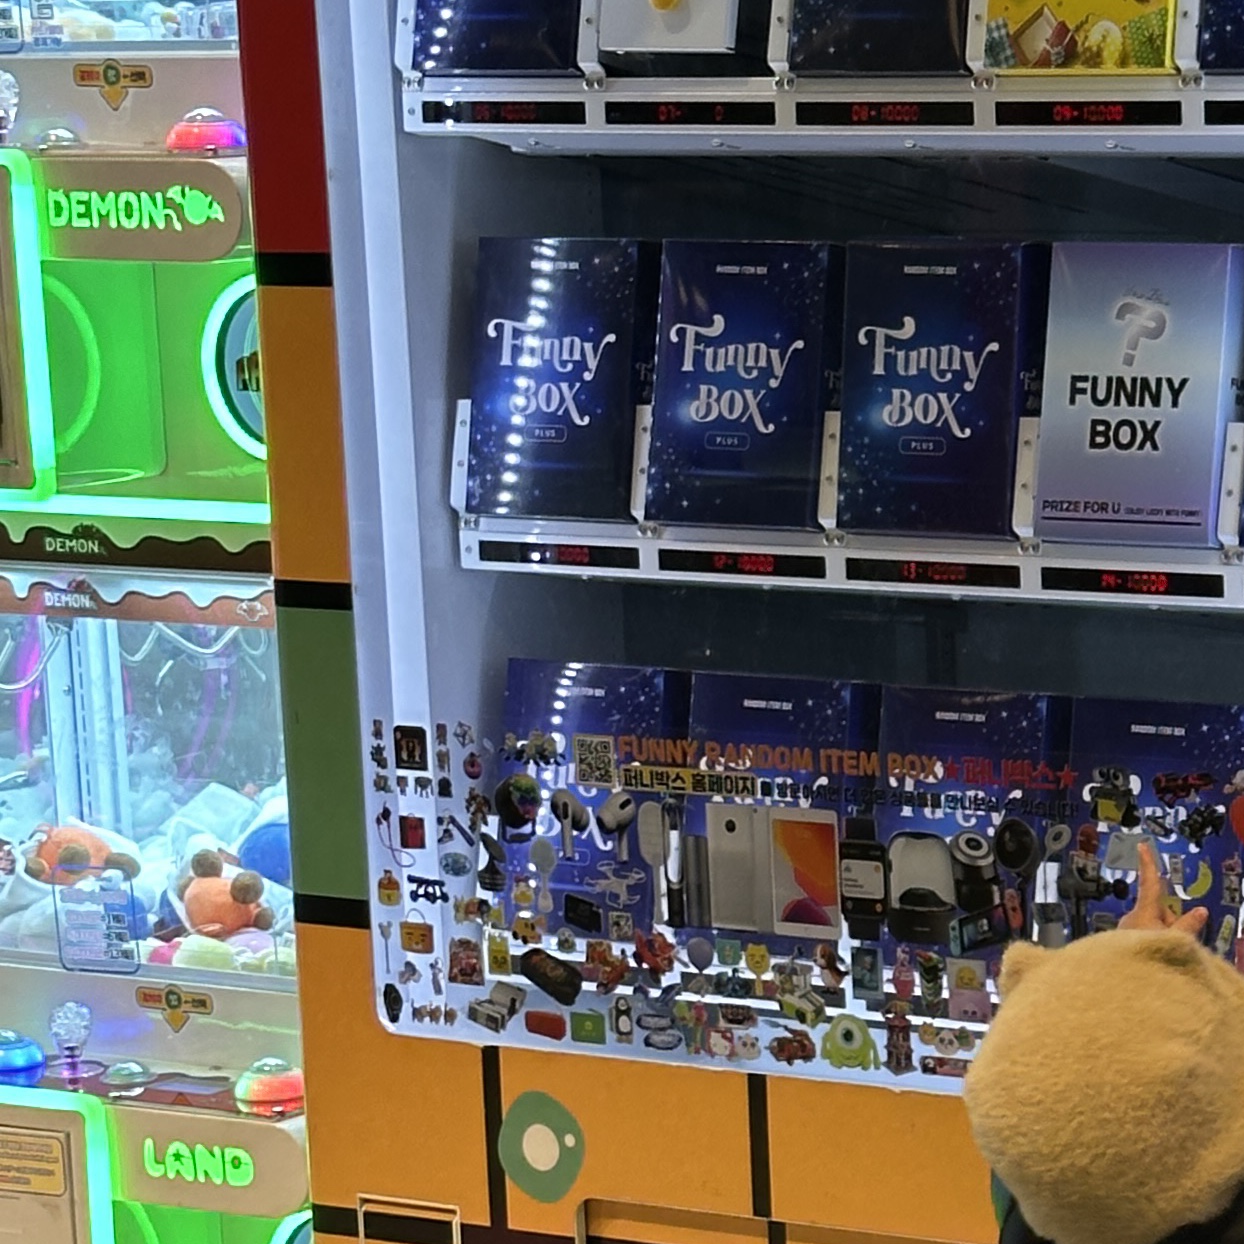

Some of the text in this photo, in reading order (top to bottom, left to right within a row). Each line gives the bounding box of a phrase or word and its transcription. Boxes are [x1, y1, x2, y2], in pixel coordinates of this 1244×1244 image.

[47, 188, 168, 230] DEMON
[669, 314, 805, 389] Funny
[858, 316, 1000, 392] Funny
[689, 384, 775, 434] BOX
[1068, 374, 1190, 409] FUNNY
[882, 388, 972, 439] BOX
[1088, 418, 1162, 451] BOX
[1042, 500, 1081, 513] PRIZE
[1083, 501, 1109, 514] FOR
[1112, 502, 1121, 514] U
[45, 537, 99, 554] DEMON
[44, 591, 91, 609] DEMON
[617, 735, 698, 765] FUNNY
[704, 740, 813, 772] RANDOM
[819, 747, 881, 778] ITEM
[887, 753, 938, 780] BOX
[622, 767, 686, 792] 퍼니박스
[691, 772, 756, 797] 홈페이지
[143, 1137, 254, 1187] LAND
